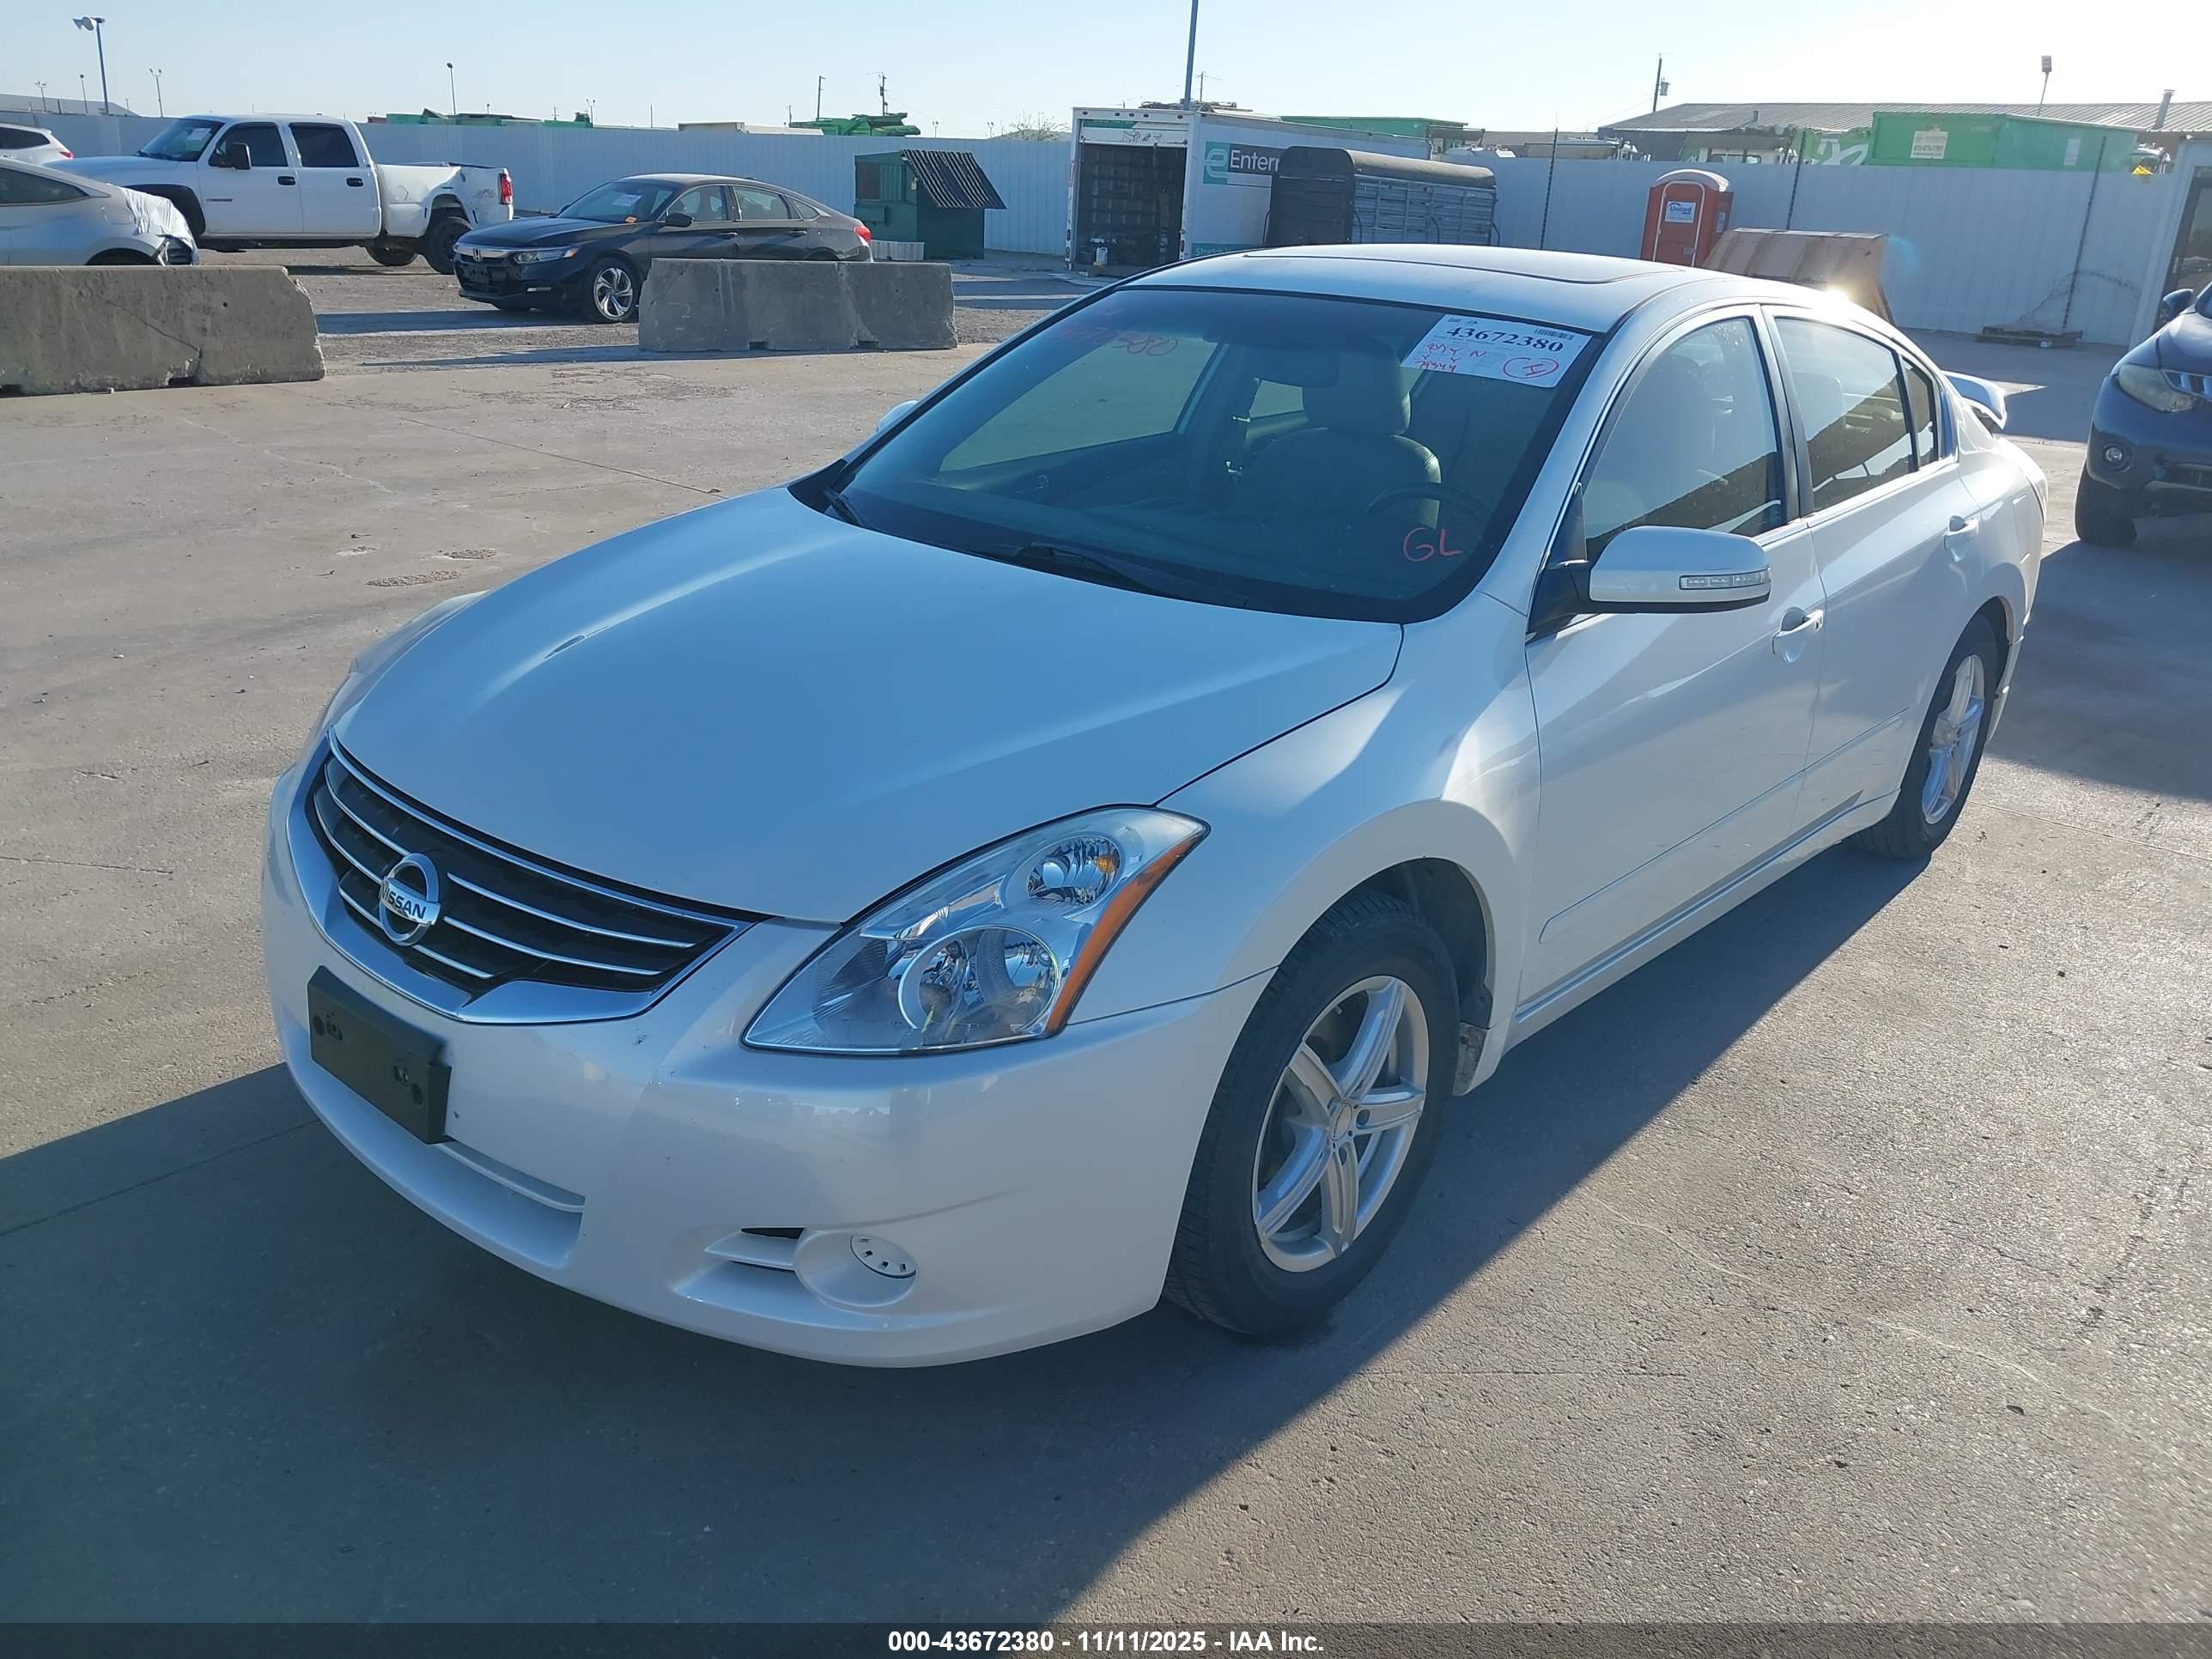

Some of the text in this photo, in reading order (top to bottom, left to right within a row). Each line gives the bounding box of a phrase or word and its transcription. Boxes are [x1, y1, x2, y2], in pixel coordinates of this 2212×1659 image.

[1446, 326, 1564, 352] 43672380
[1402, 527, 1463, 562] GL
[380, 881, 427, 920] NISSAN
